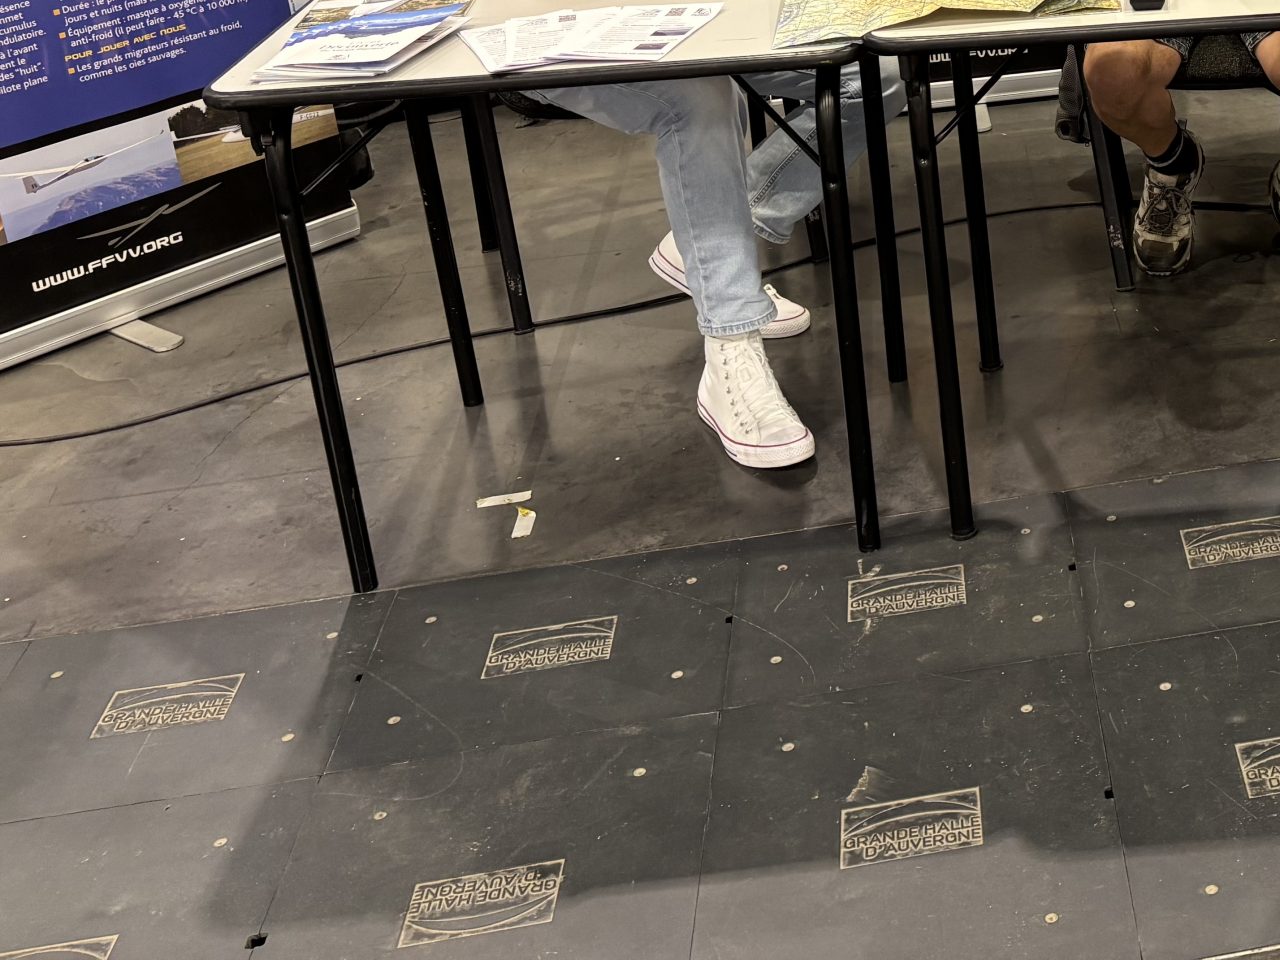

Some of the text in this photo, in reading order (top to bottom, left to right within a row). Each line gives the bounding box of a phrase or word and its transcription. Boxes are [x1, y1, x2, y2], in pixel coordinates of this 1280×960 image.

[64, 24, 186, 61] POUR JOUER AVEC NOUS
[76, 63, 92, 72] Les
[93, 54, 123, 69] grands
[124, 41, 168, 59] migrateurs
[170, 31, 207, 45] résistant
[31, 231, 183, 292] WWW.FFVV.ORG
[844, 828, 919, 849] GRANDE
